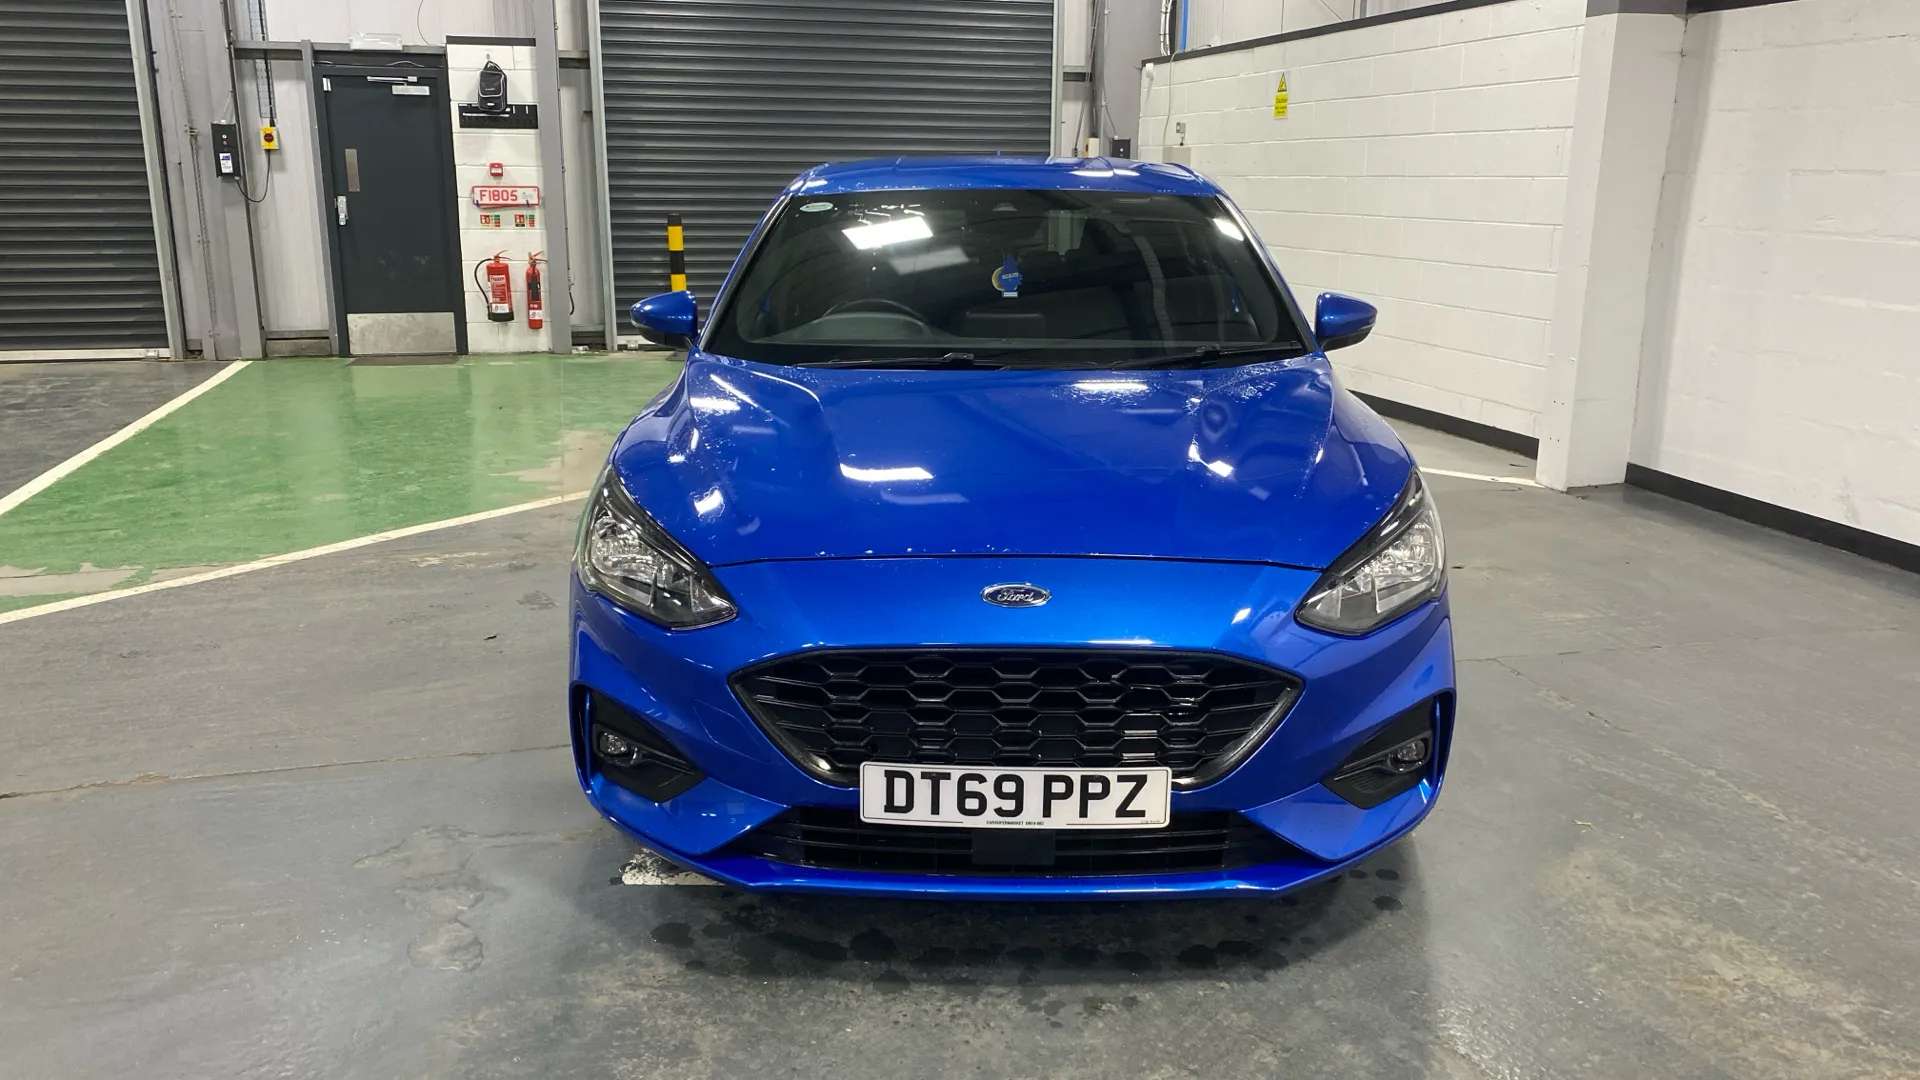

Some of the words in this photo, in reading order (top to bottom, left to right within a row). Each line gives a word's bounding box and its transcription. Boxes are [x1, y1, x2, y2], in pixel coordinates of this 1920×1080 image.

[997, 587, 1034, 602] Ford
[883, 769, 1024, 817] DT69
[1042, 774, 1148, 818] PPZ
